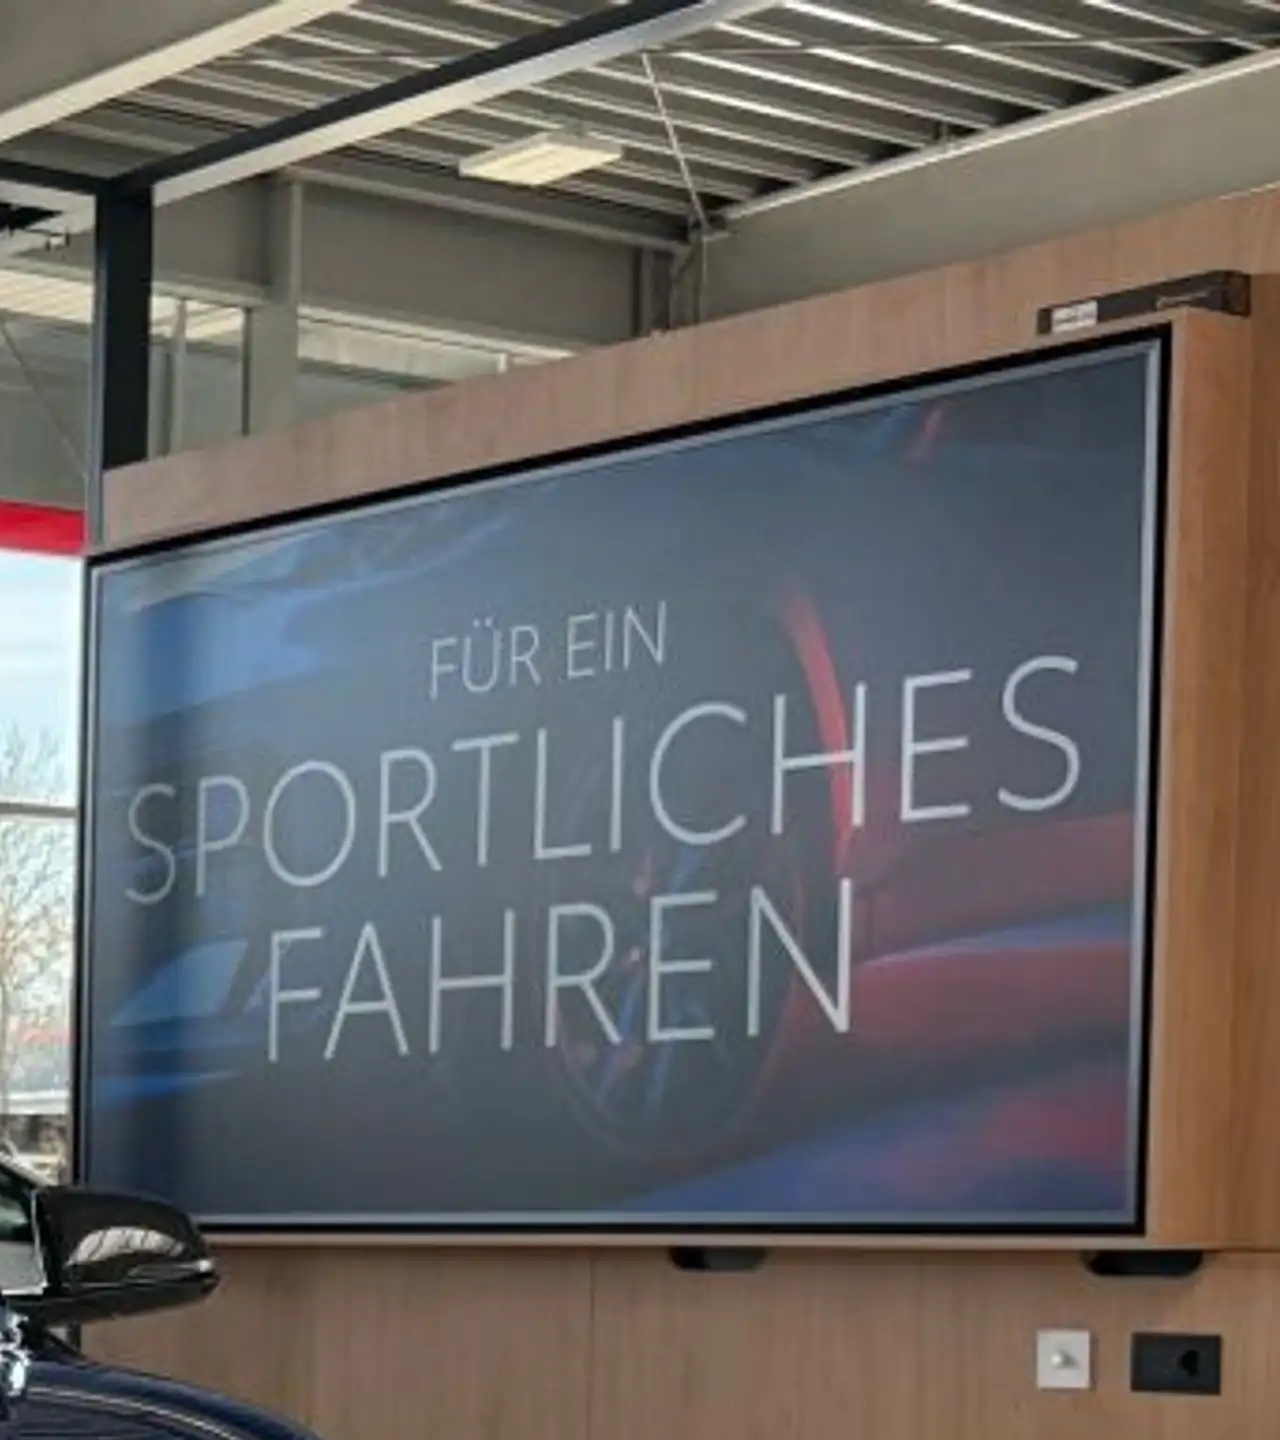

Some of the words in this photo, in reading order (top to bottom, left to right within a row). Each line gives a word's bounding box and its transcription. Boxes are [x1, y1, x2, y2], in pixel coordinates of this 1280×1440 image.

[428, 616, 542, 701] FÜR
[567, 600, 668, 681] EIN
[124, 655, 1081, 905] SPORTLICHES
[266, 878, 852, 1063] FAHREN
